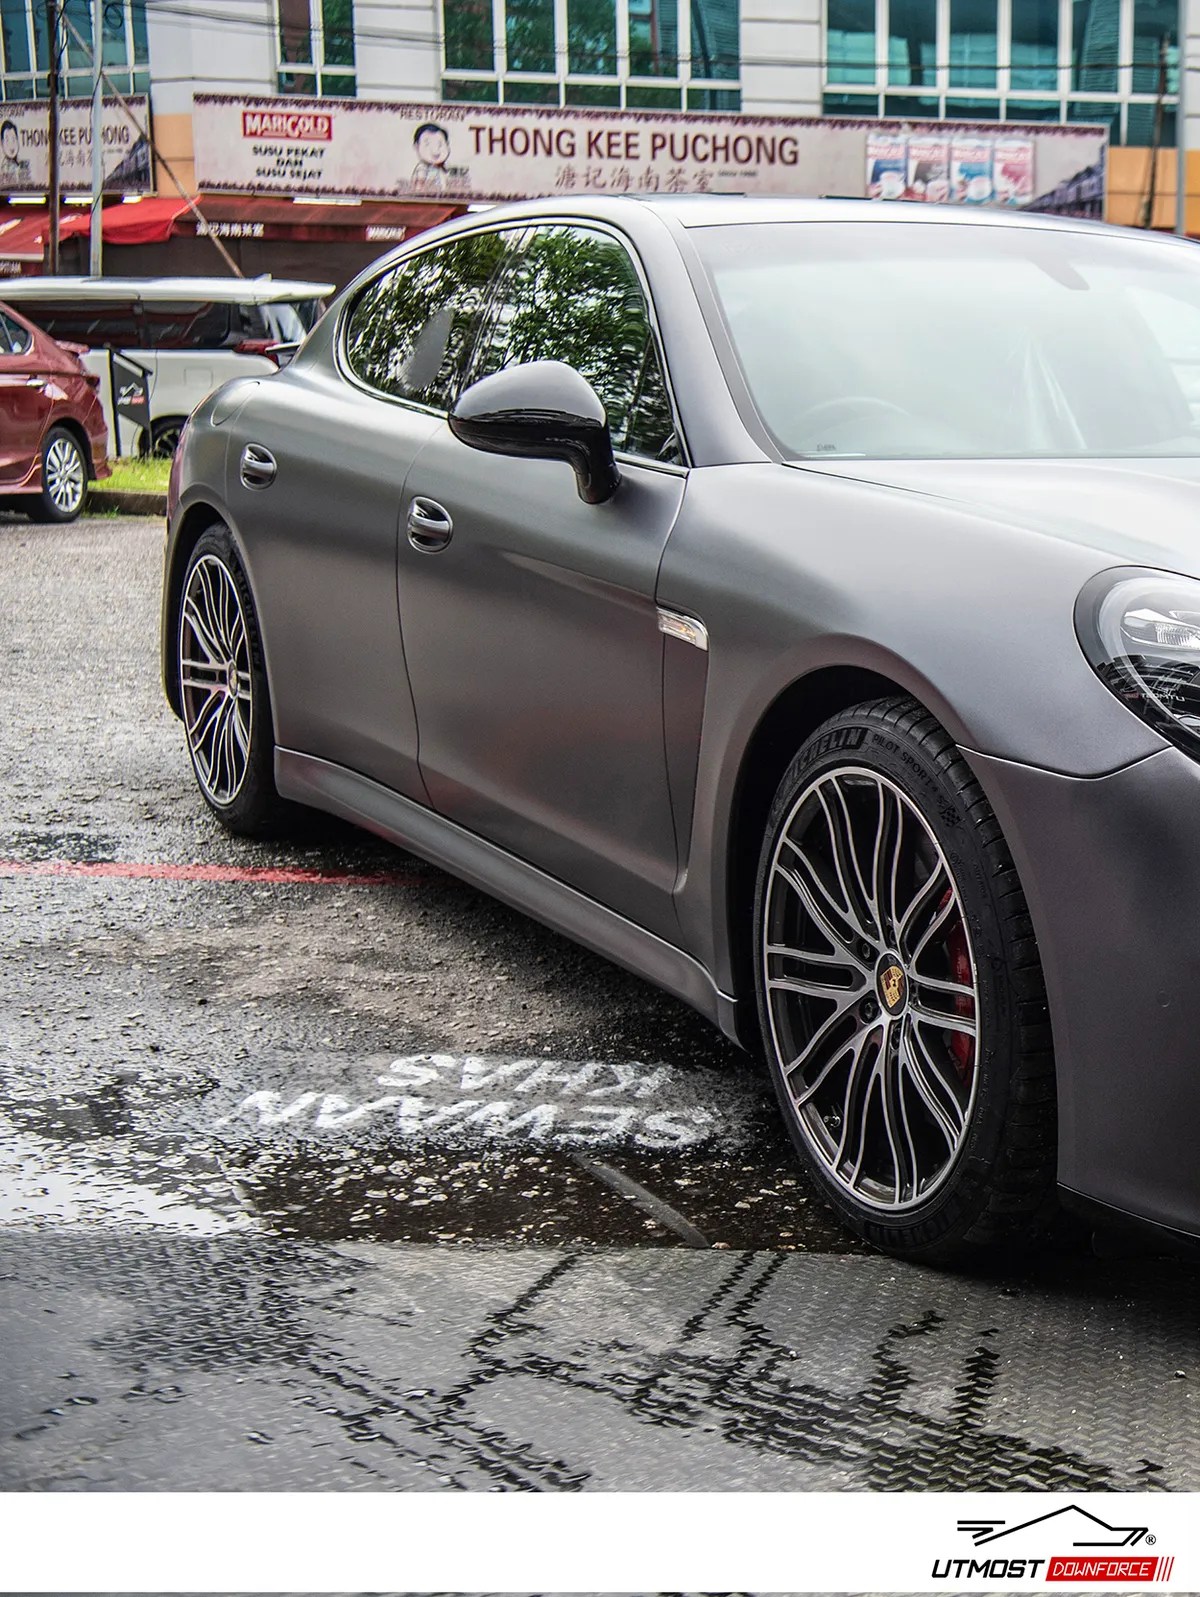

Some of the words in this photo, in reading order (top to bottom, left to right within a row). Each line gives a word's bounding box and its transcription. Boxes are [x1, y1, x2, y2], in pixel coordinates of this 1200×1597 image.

[245, 113, 329, 138] MARIGOLD
[400, 108, 466, 121] RESTORAN
[20, 128, 48, 147] THON
[79, 125, 129, 146] PUHONG
[469, 126, 576, 158] THONG
[587, 129, 641, 160] KEE
[651, 133, 799, 165] PUCHONG
[252, 146, 283, 156] SUSU
[287, 147, 326, 159] PEKAT
[276, 159, 304, 167] DAN
[255, 168, 286, 178] SUSU
[290, 169, 323, 181] SEJAT
[872, 734, 901, 754] PILOT
[901, 752, 935, 785] SPORT
[378, 1054, 678, 1099] KHAS
